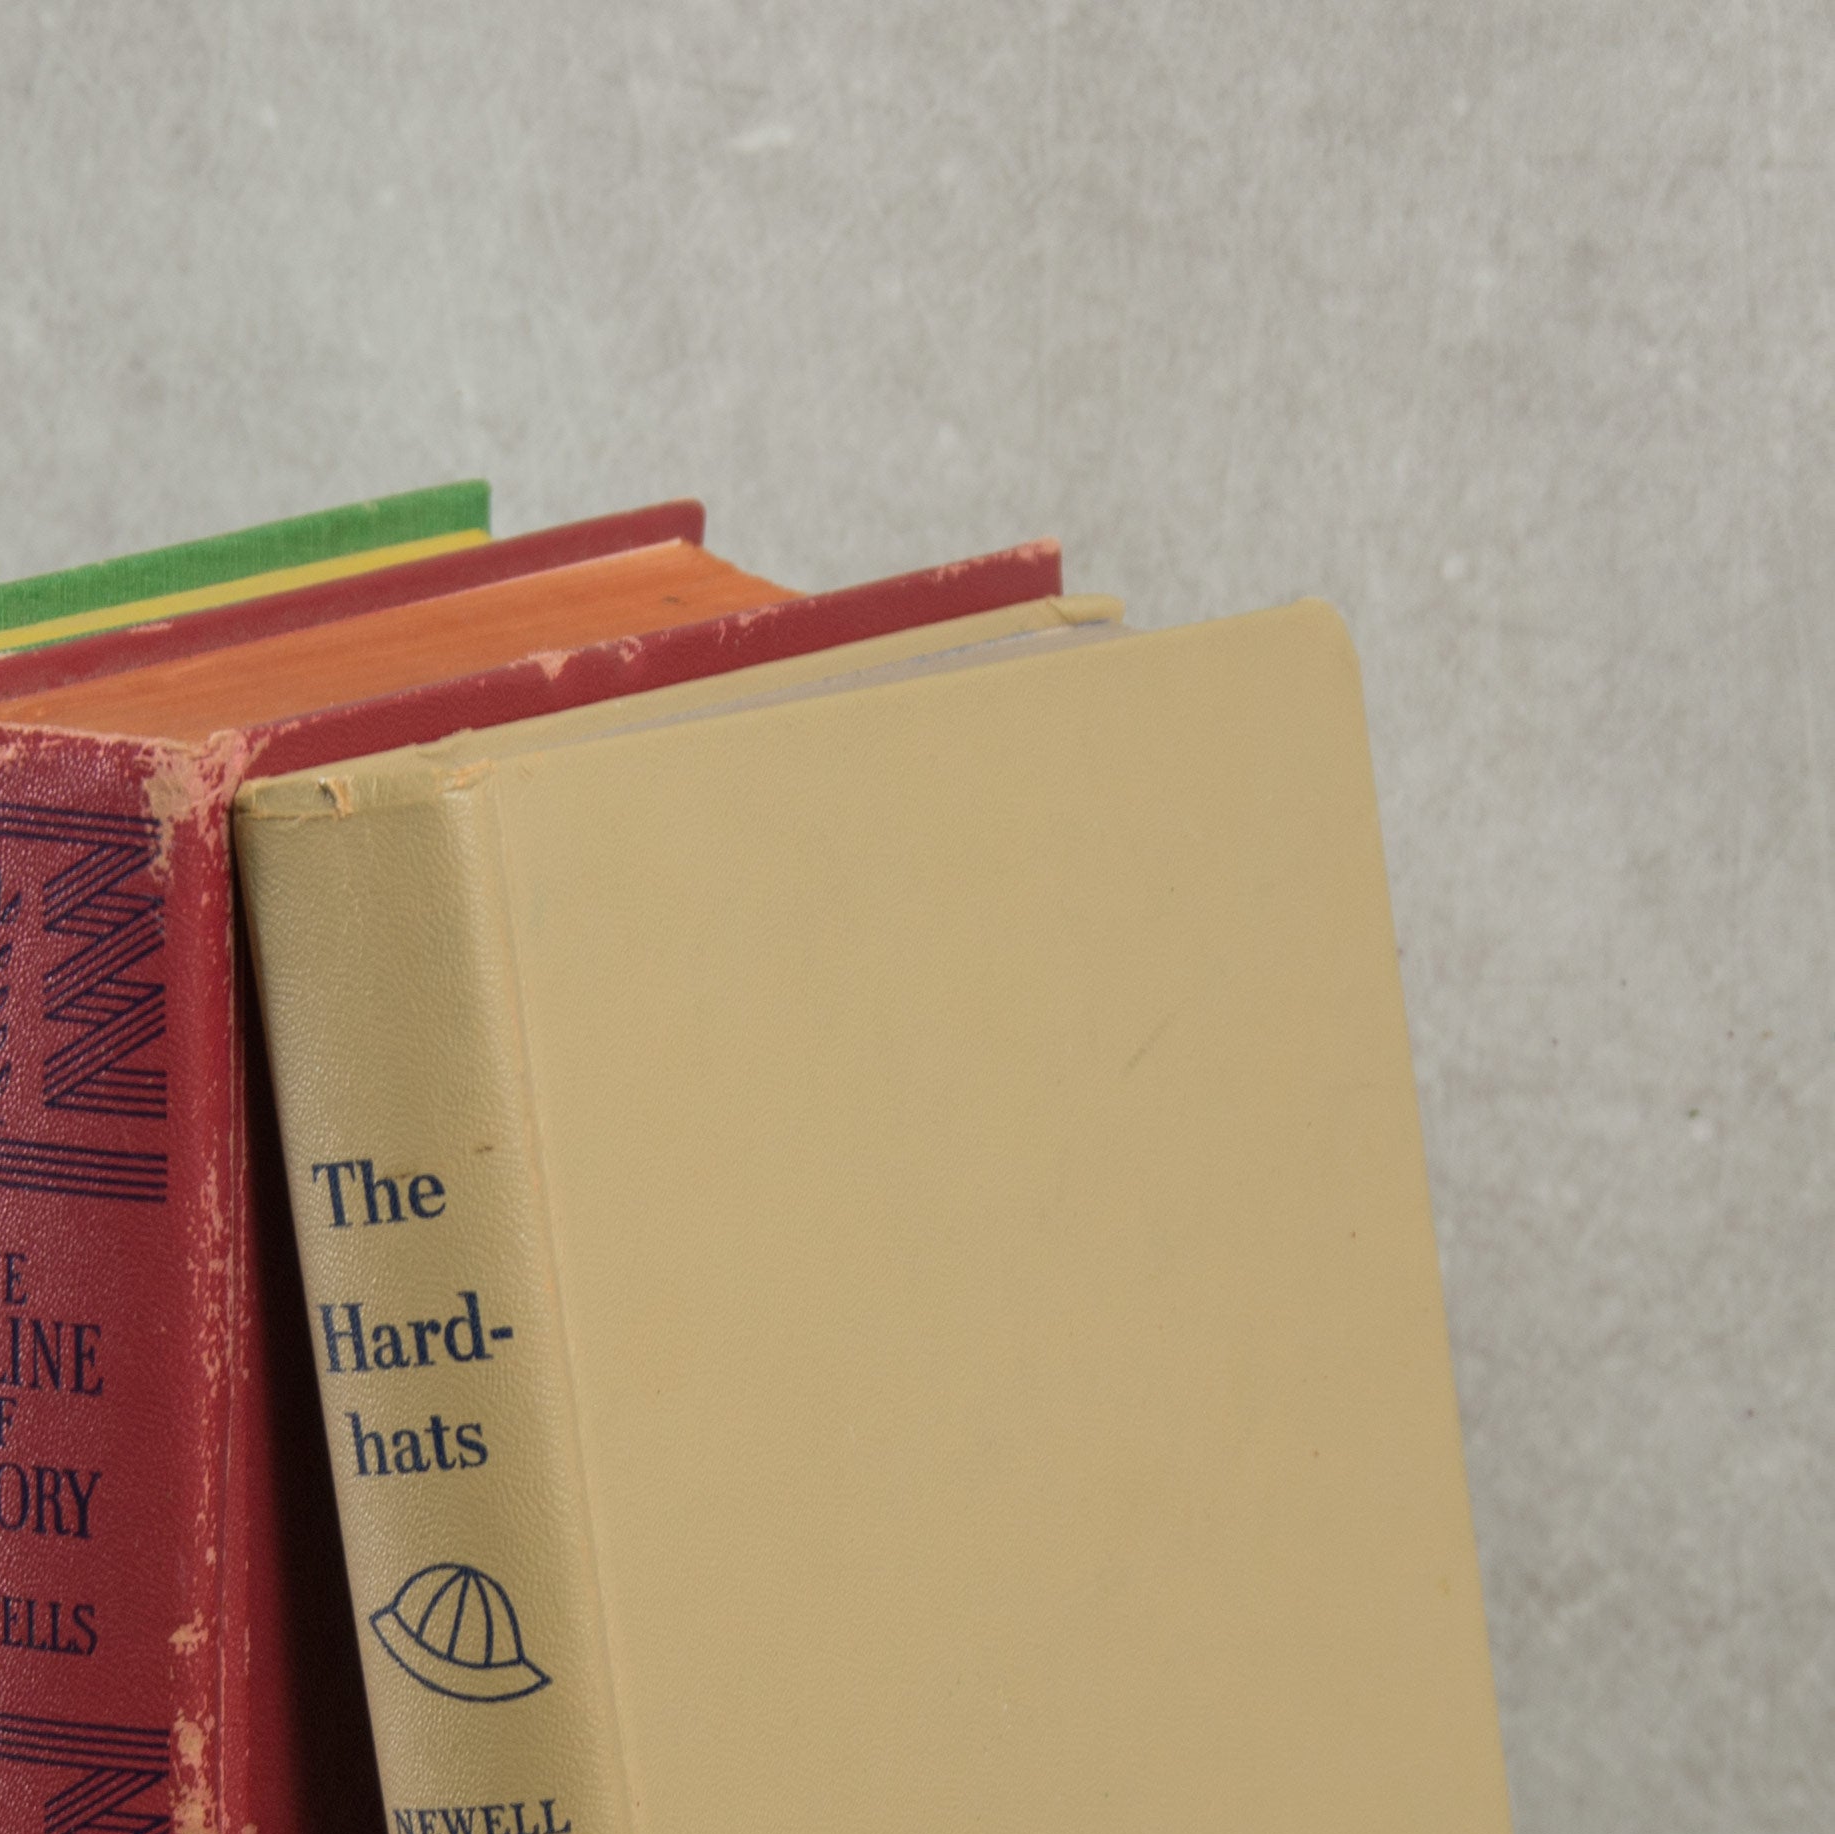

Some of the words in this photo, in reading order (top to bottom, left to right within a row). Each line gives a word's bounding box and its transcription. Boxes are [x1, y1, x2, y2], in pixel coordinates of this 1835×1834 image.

[312, 1157, 447, 1229] The
[319, 1290, 514, 1374] Hard-
[345, 1411, 489, 1477] hats
